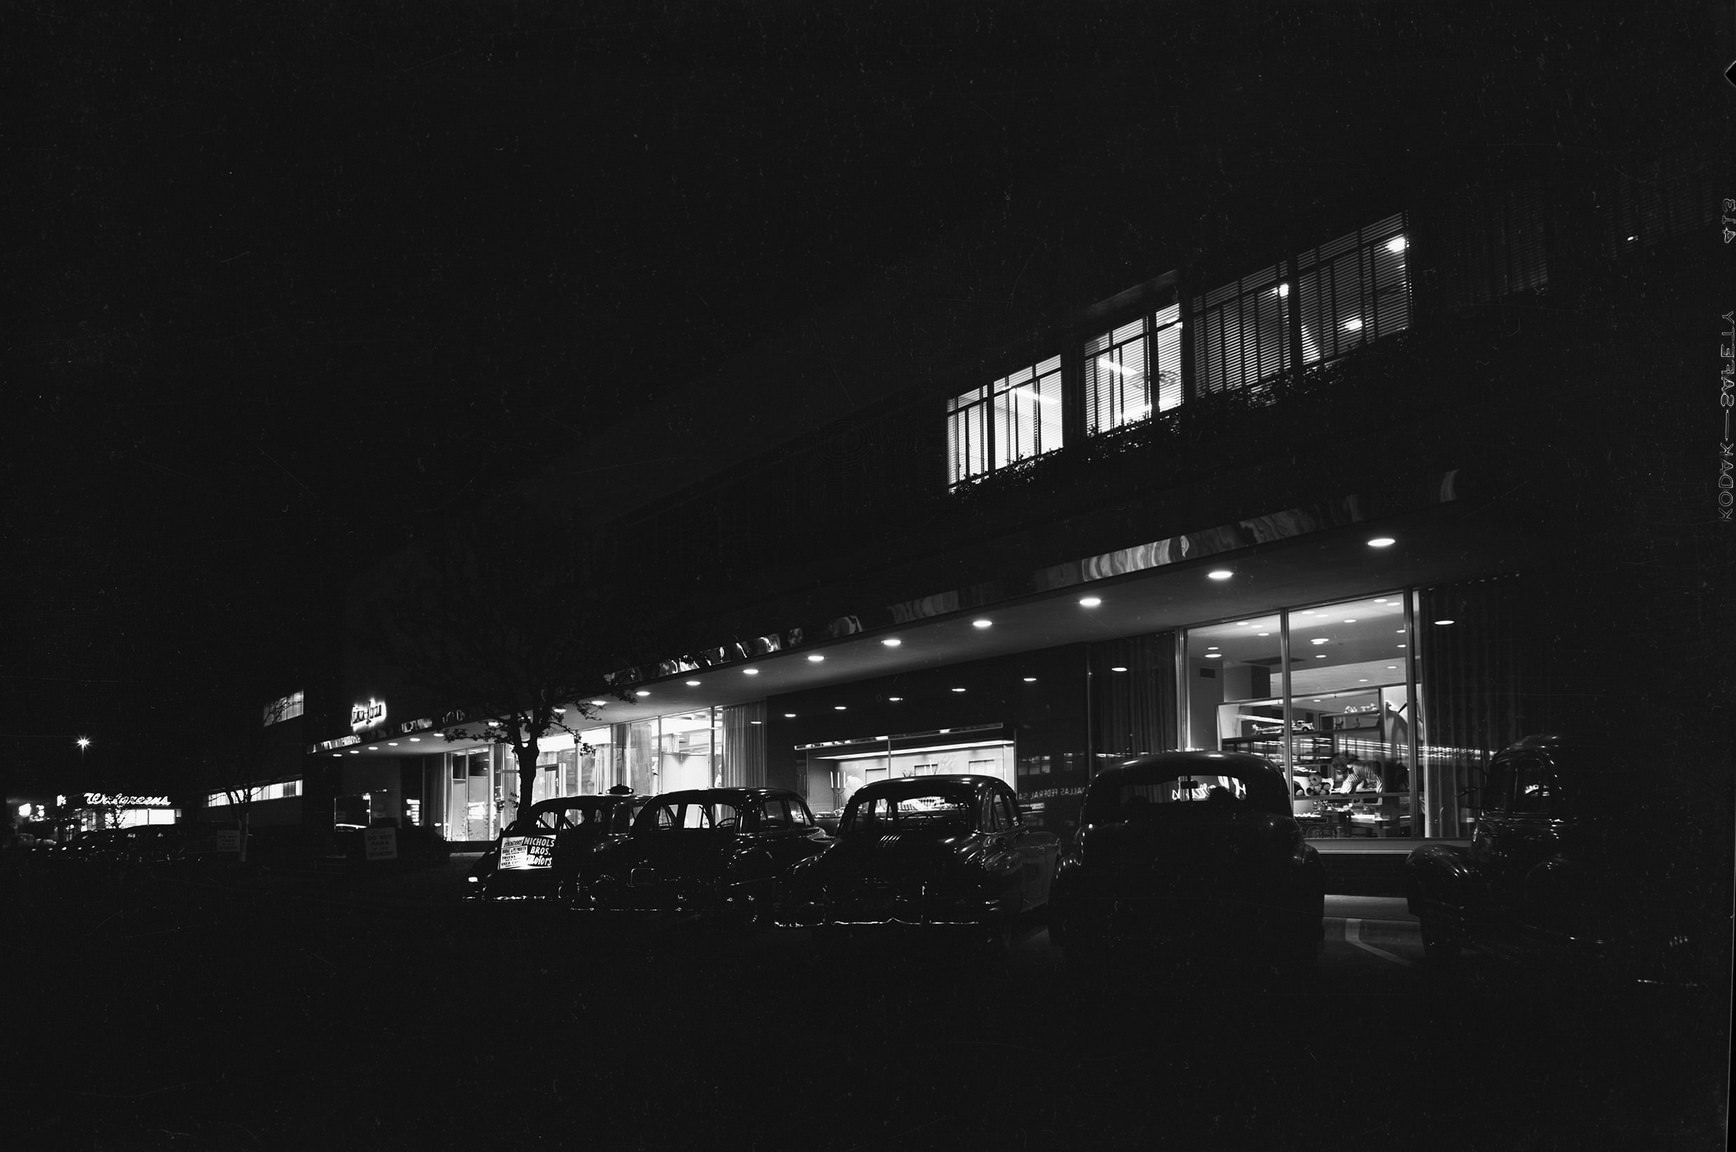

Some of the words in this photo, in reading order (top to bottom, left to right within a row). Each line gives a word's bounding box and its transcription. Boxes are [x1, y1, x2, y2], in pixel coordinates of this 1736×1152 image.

[83, 792, 171, 806] Walgreens
[524, 837, 555, 847] NICHOLS
[530, 846, 551, 855] BROS.
